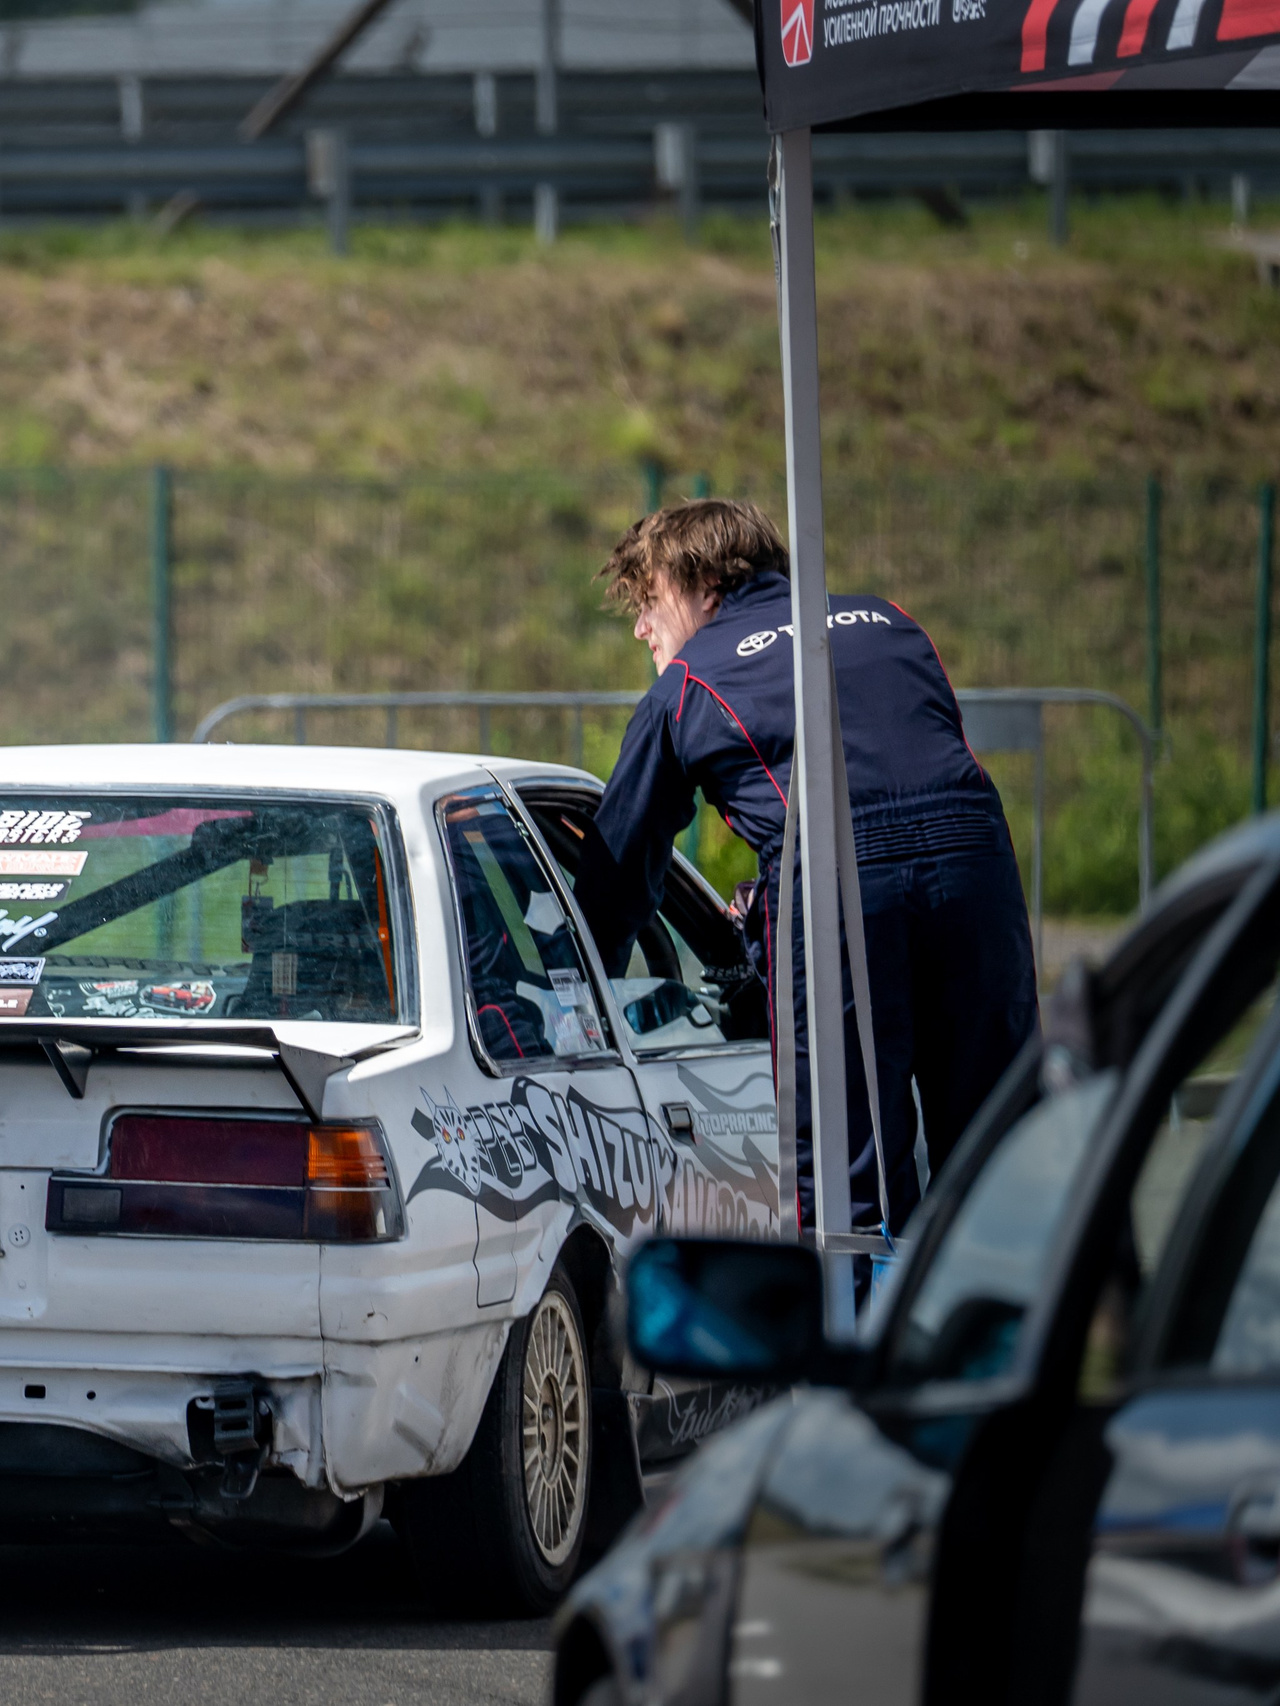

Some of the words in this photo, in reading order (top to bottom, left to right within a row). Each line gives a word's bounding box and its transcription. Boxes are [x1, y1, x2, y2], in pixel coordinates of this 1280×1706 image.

[823, 1, 878, 48] УСИЛЕННОЙ
[878, 0, 941, 35] ПРОЧНОСТИ
[778, 609, 892, 637] TOTA
